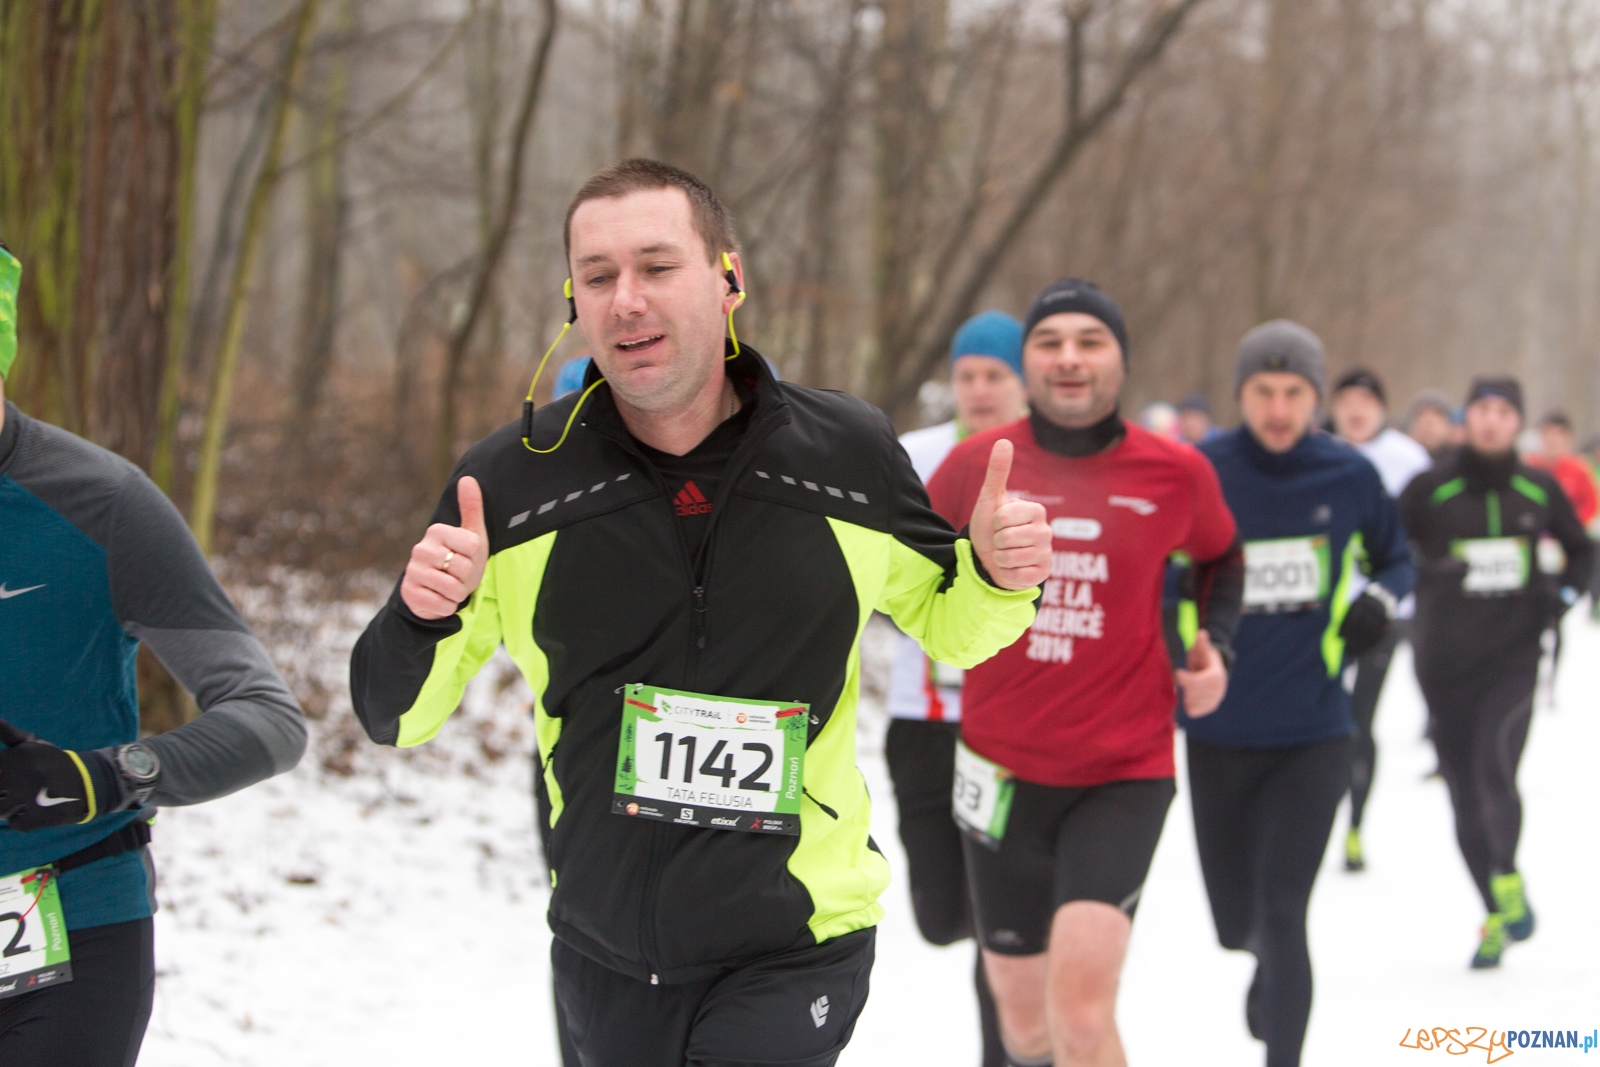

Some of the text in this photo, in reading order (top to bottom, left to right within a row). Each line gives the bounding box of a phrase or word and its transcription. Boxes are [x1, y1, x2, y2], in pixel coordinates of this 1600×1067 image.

[1050, 551, 1109, 582] URSA
[1063, 581, 1093, 608] LA
[1026, 633, 1074, 665] 2014
[654, 732, 774, 792] 1142
[785, 756, 800, 800] Poznań
[666, 786, 753, 808] TATA FELUSIA
